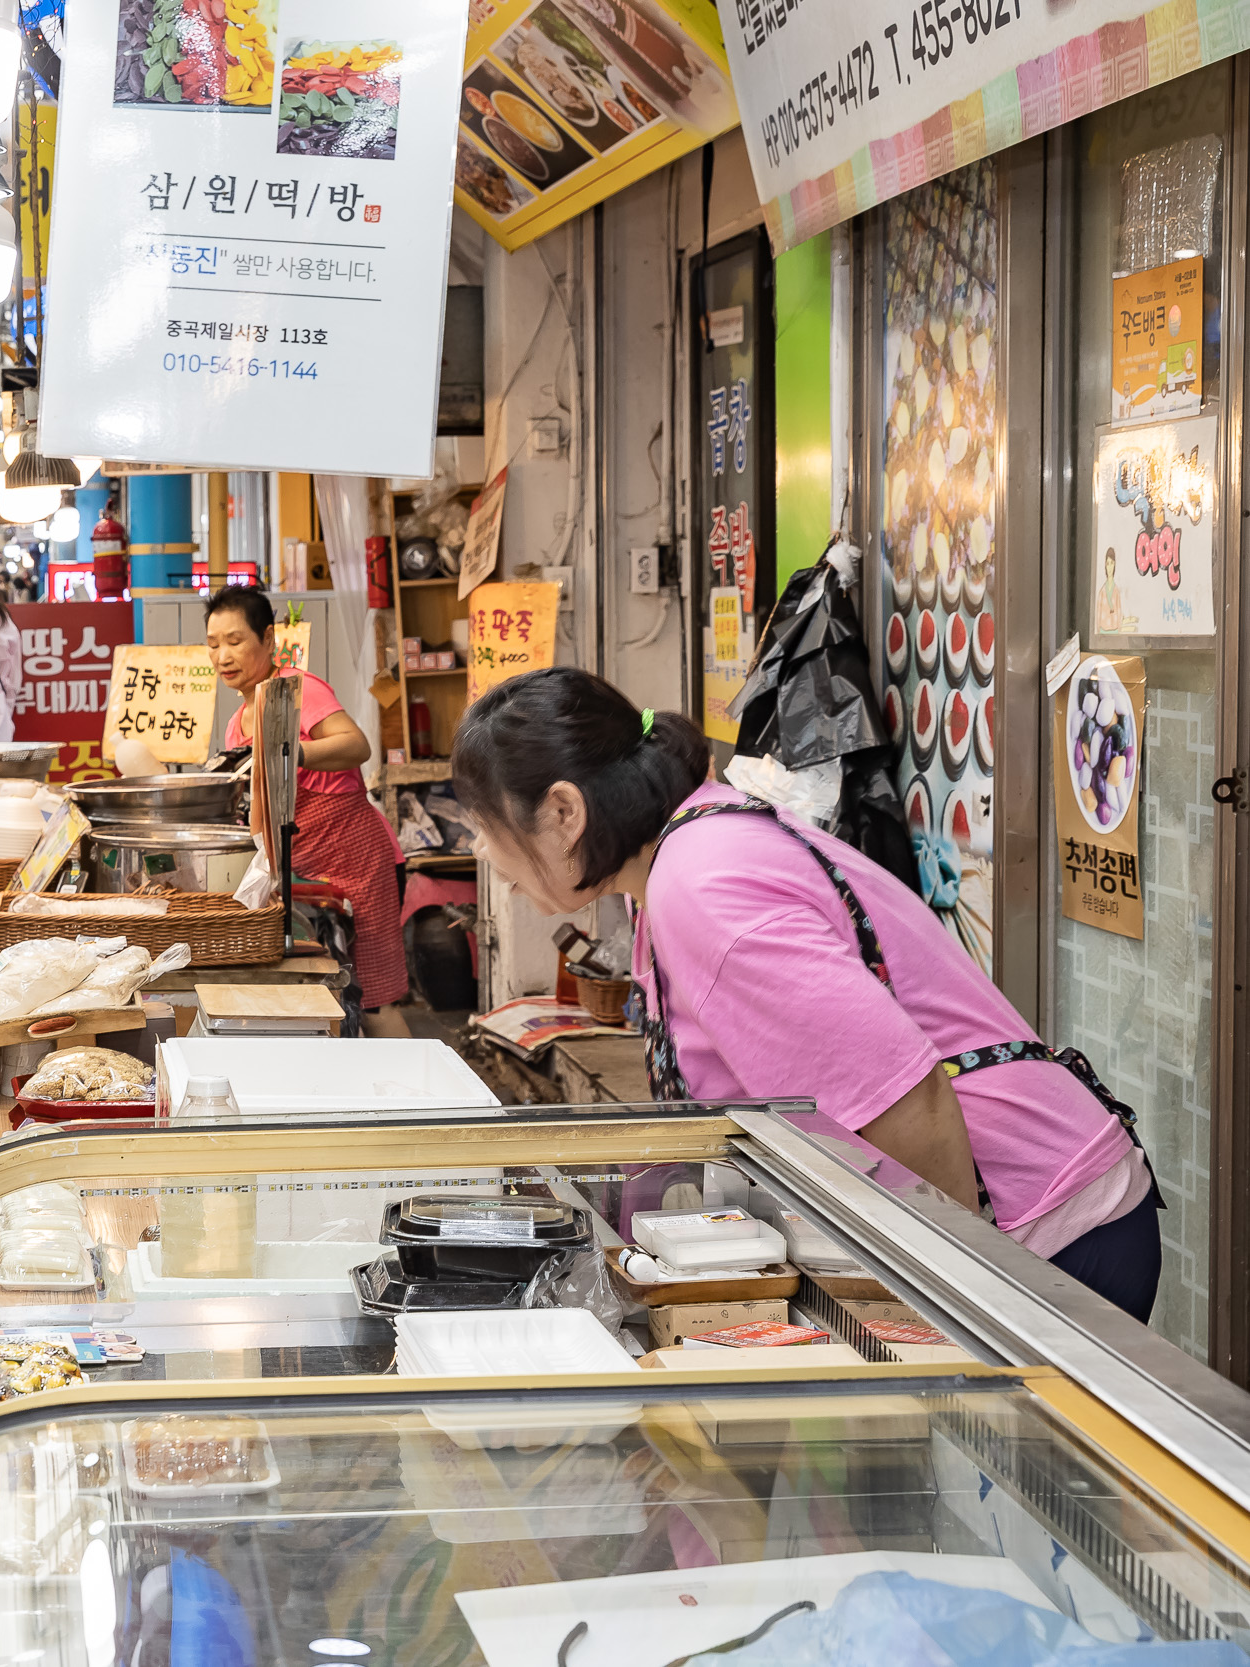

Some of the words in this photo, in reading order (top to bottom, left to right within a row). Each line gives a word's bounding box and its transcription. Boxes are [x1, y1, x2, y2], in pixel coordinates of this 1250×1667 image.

[233, 254, 272, 277] 쌀만
[276, 257, 377, 283] 사용합니다.
[166, 320, 269, 342] 중곡제일시장
[280, 328, 329, 345] 113호
[163, 353, 318, 380] 010-5416-1144
[1135, 524, 1182, 591] 여인
[492, 609, 533, 643] 팥죽
[21, 626, 112, 676] 땅스
[1065, 836, 1138, 900] 추석송편
